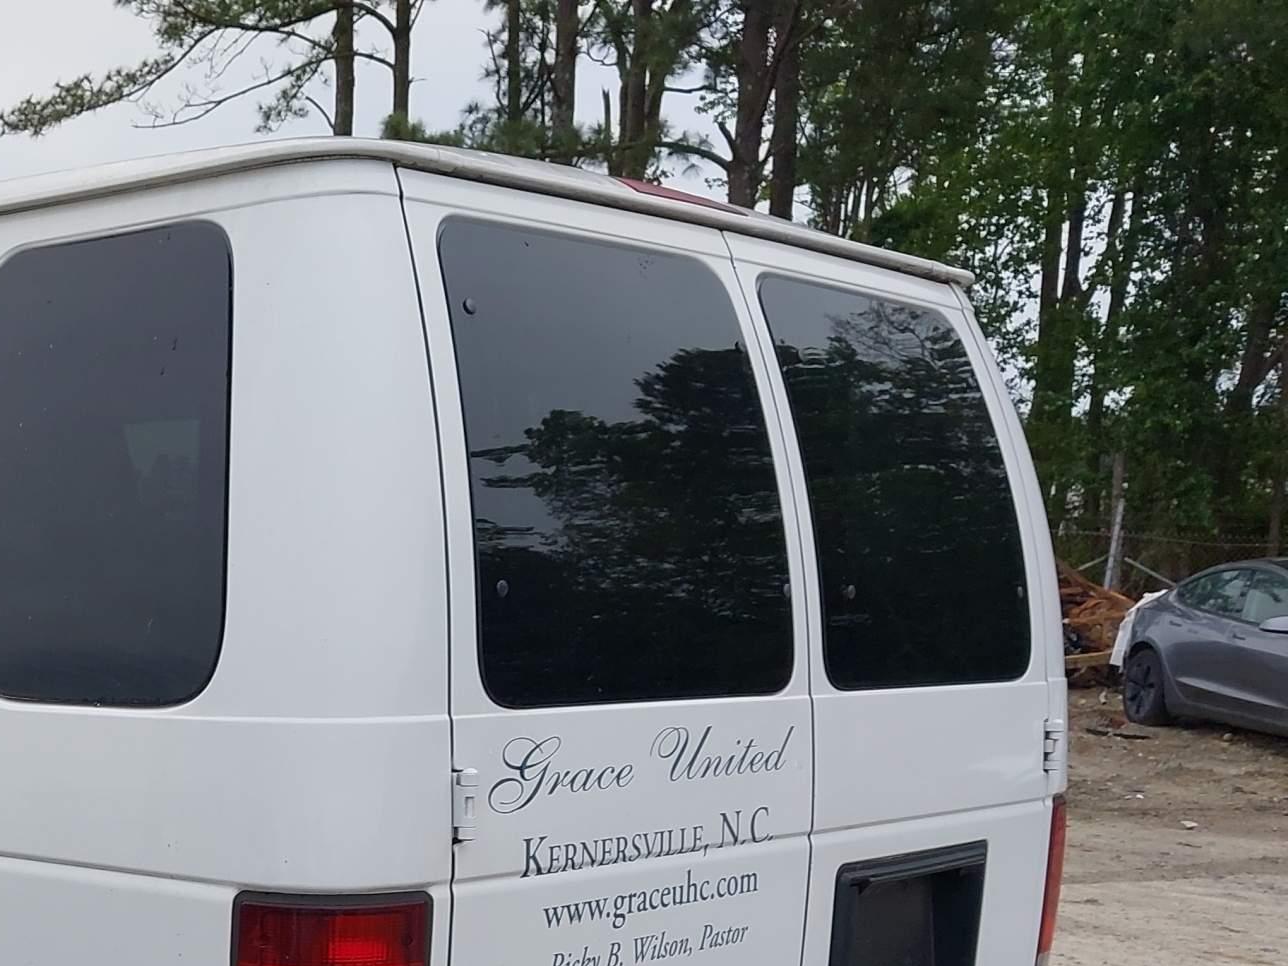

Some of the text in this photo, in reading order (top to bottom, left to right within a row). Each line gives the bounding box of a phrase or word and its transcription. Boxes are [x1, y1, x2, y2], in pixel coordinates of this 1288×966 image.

[488, 725, 794, 814] Grace United
[718, 806, 775, 850] N.C.
[542, 869, 759, 930] www.graceuhc.com
[632, 930, 693, 965] Wilson,
[699, 923, 749, 951] Pastor
